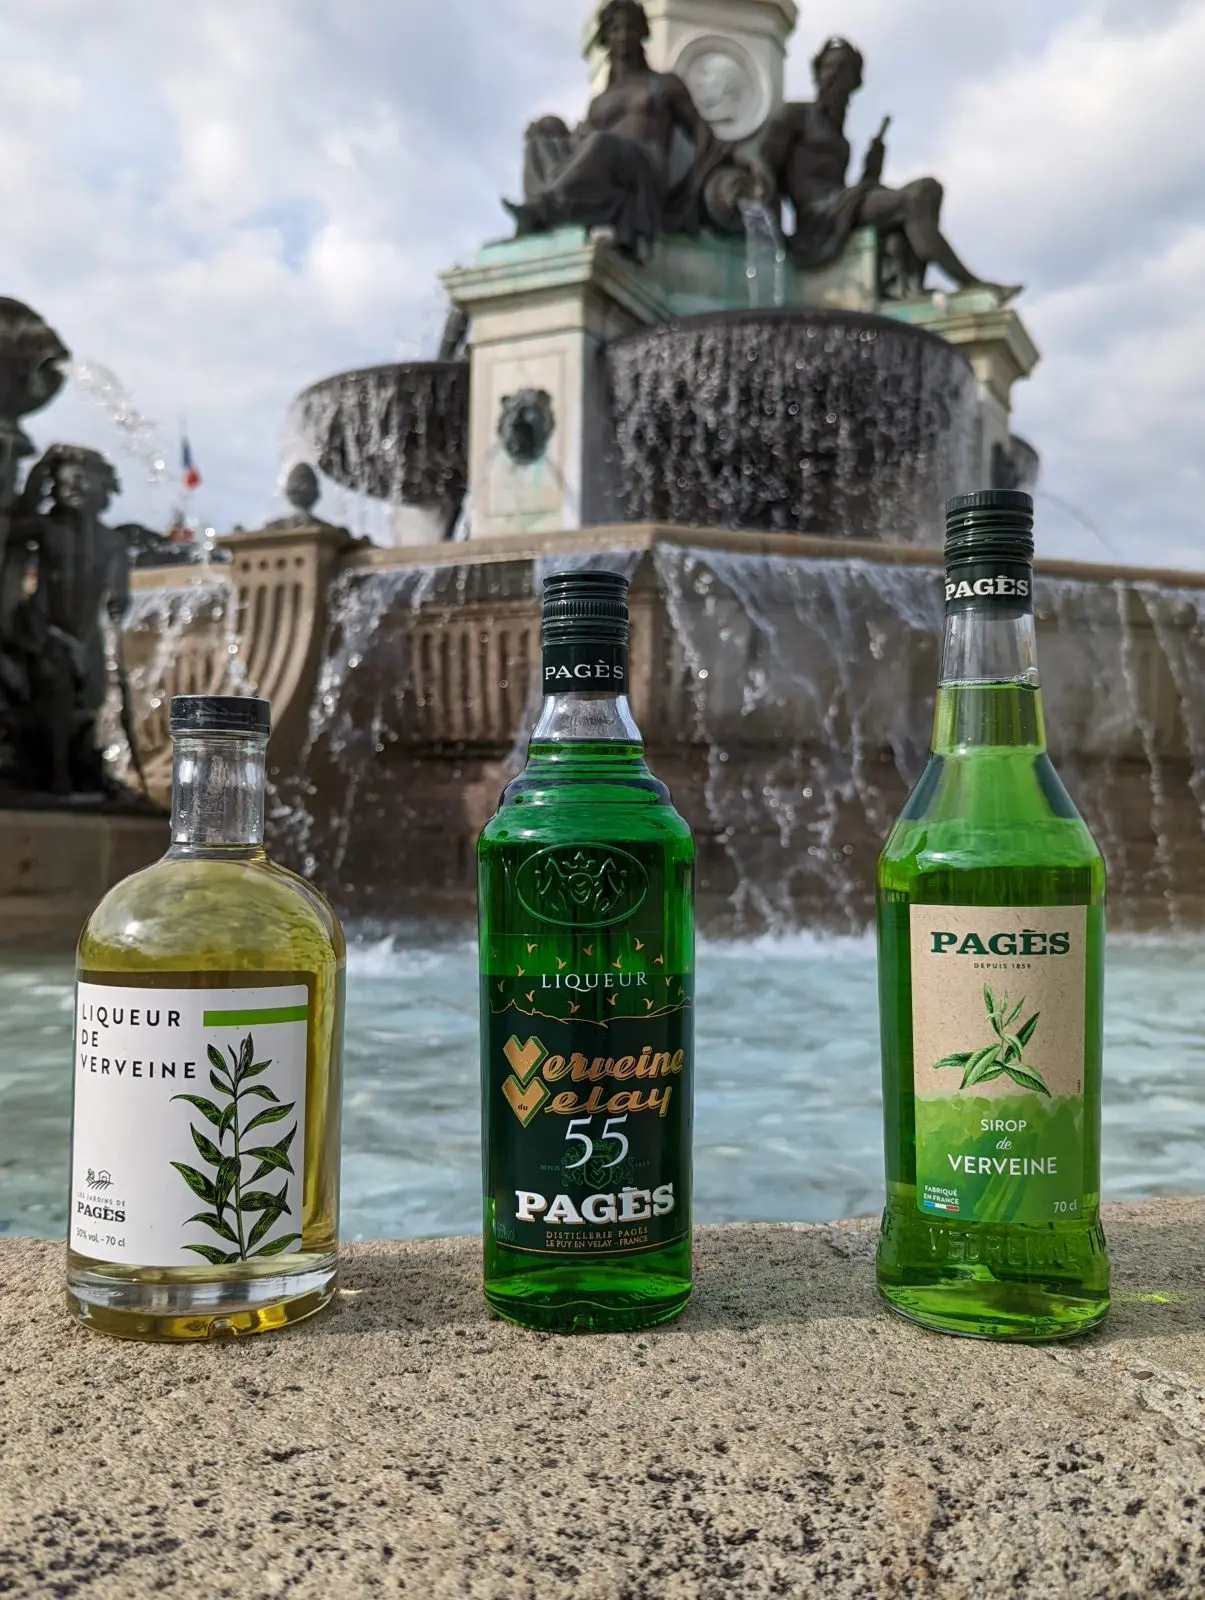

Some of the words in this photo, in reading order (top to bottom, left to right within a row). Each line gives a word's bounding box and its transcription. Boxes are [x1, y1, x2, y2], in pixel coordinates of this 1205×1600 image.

[945, 575, 1028, 601] PAGÈS
[545, 659, 624, 680] PAGÈS
[930, 928, 1071, 956] PAGÈS
[973, 962, 1008, 970] DEPUIS
[541, 971, 648, 992] LIQUEUR
[82, 1004, 181, 1028] LIQUEUR
[81, 1029, 99, 1048] DE
[80, 1053, 197, 1079] VERVEINE
[517, 1103, 528, 1111] du
[980, 1118, 1027, 1132] SIROP
[564, 1113, 629, 1169] 55
[995, 1136, 1012, 1150] de
[947, 1153, 1058, 1176] VERVEINE
[116, 1199, 127, 1207] DE
[515, 1182, 675, 1224] PAGÈS
[932, 1195, 960, 1205] FRANCE
[1053, 1201, 1066, 1213] 70
[1068, 1200, 1078, 1211] cl
[77, 1200, 126, 1223] PAGÈS
[105, 1235, 117, 1246] 70
[117, 1237, 126, 1247] cl
[545, 1239, 555, 1247] LE
[556, 1240, 574, 1248] PUY
[574, 1240, 586, 1248] EN
[587, 1239, 612, 1248] VELAY
[619, 1235, 648, 1246] FRANCE
[546, 1231, 613, 1240] DISTILLERIE
